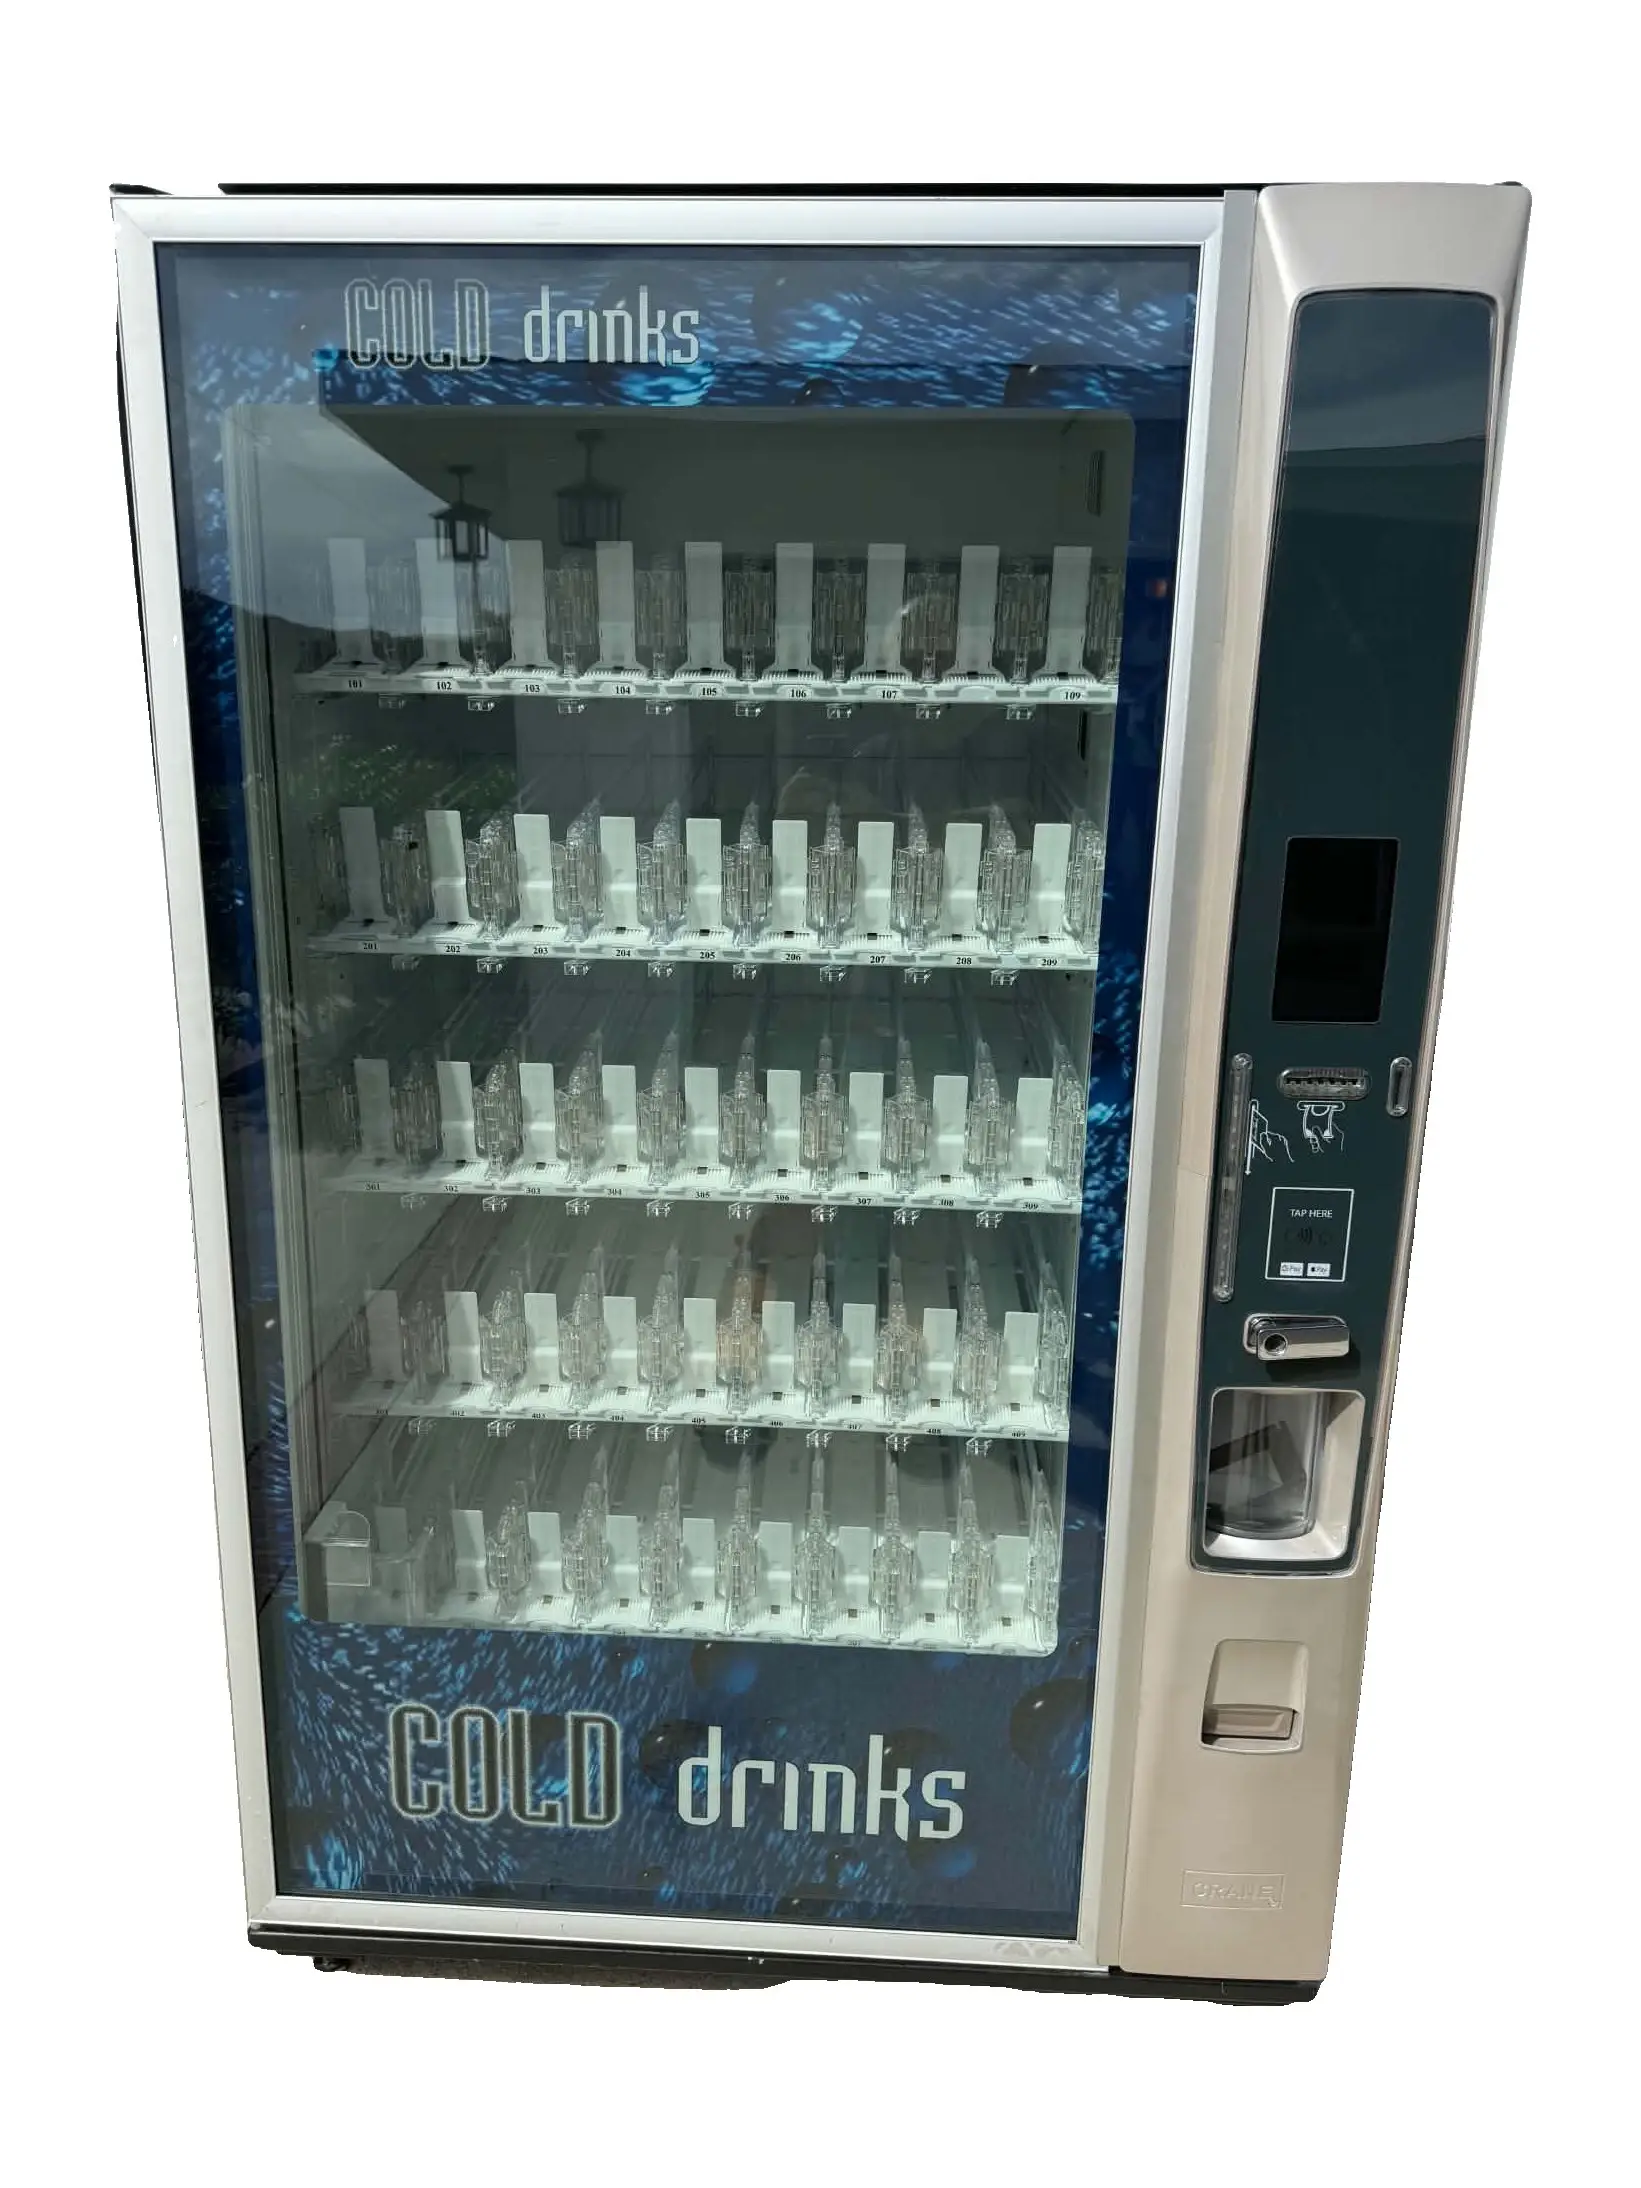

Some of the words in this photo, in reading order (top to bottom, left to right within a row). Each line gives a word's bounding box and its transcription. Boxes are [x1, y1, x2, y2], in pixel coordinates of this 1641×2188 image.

[345, 278, 491, 371] COLD
[523, 285, 699, 367] drinks
[437, 681, 452, 690] 102
[524, 684, 540, 693] 103
[615, 686, 630, 695] 104
[701, 687, 717, 696] 105
[791, 689, 807, 698] 106
[881, 690, 897, 699] 107
[1064, 691, 1081, 700] 109
[363, 942, 378, 950] 201
[446, 945, 460, 953] 202
[533, 947, 548, 955] 203
[616, 949, 631, 957] 204
[699, 951, 715, 959] 205
[785, 953, 801, 961] 206
[870, 956, 886, 964] 207
[956, 957, 972, 965] 208
[1041, 959, 1057, 967] 209
[1290, 1208, 1307, 1218] TAP
[1309, 1209, 1333, 1218] HERE
[388, 1701, 623, 1830] COLD
[678, 1725, 966, 1841] drinks
